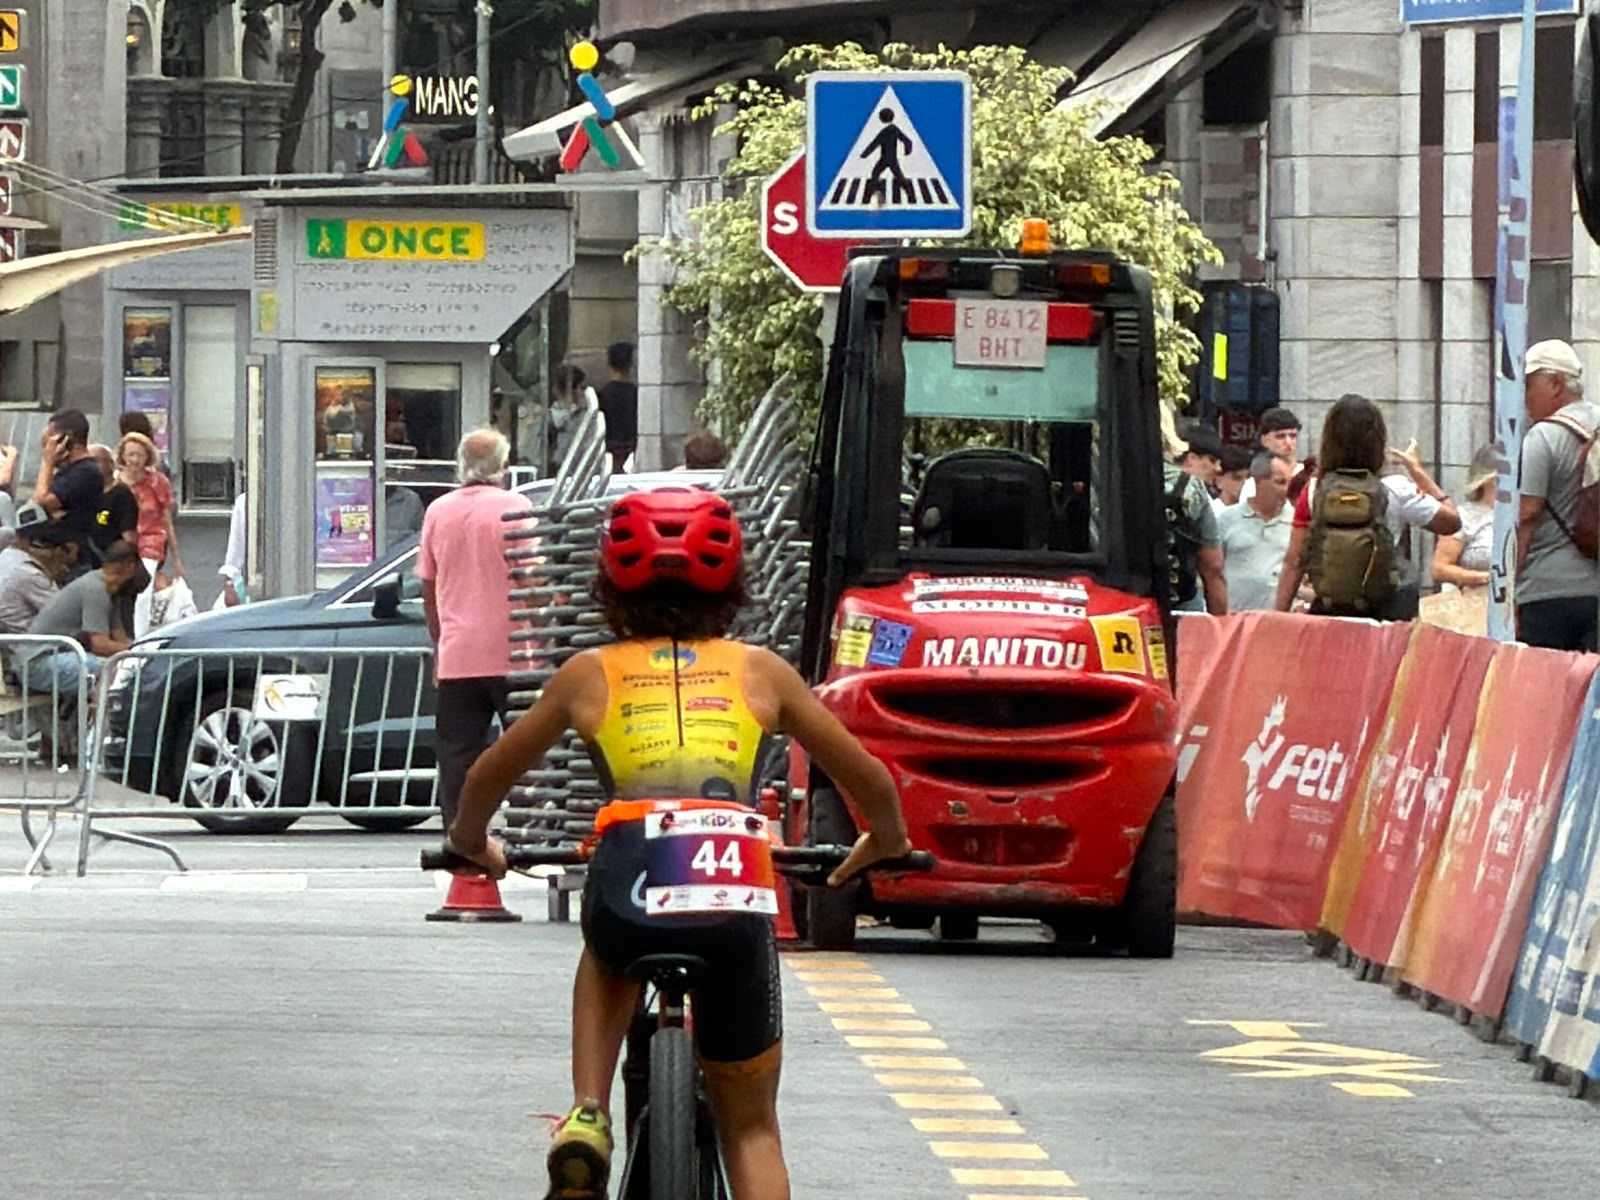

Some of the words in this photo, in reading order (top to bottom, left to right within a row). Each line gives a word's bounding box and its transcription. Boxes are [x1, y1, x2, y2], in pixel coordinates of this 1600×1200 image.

[360, 226, 471, 256] ONCE
[963, 306, 976, 329] E
[985, 307, 1041, 333] 8412
[979, 336, 1023, 359] BHT
[922, 637, 1088, 671] MANITOU
[691, 839, 744, 877] 44
